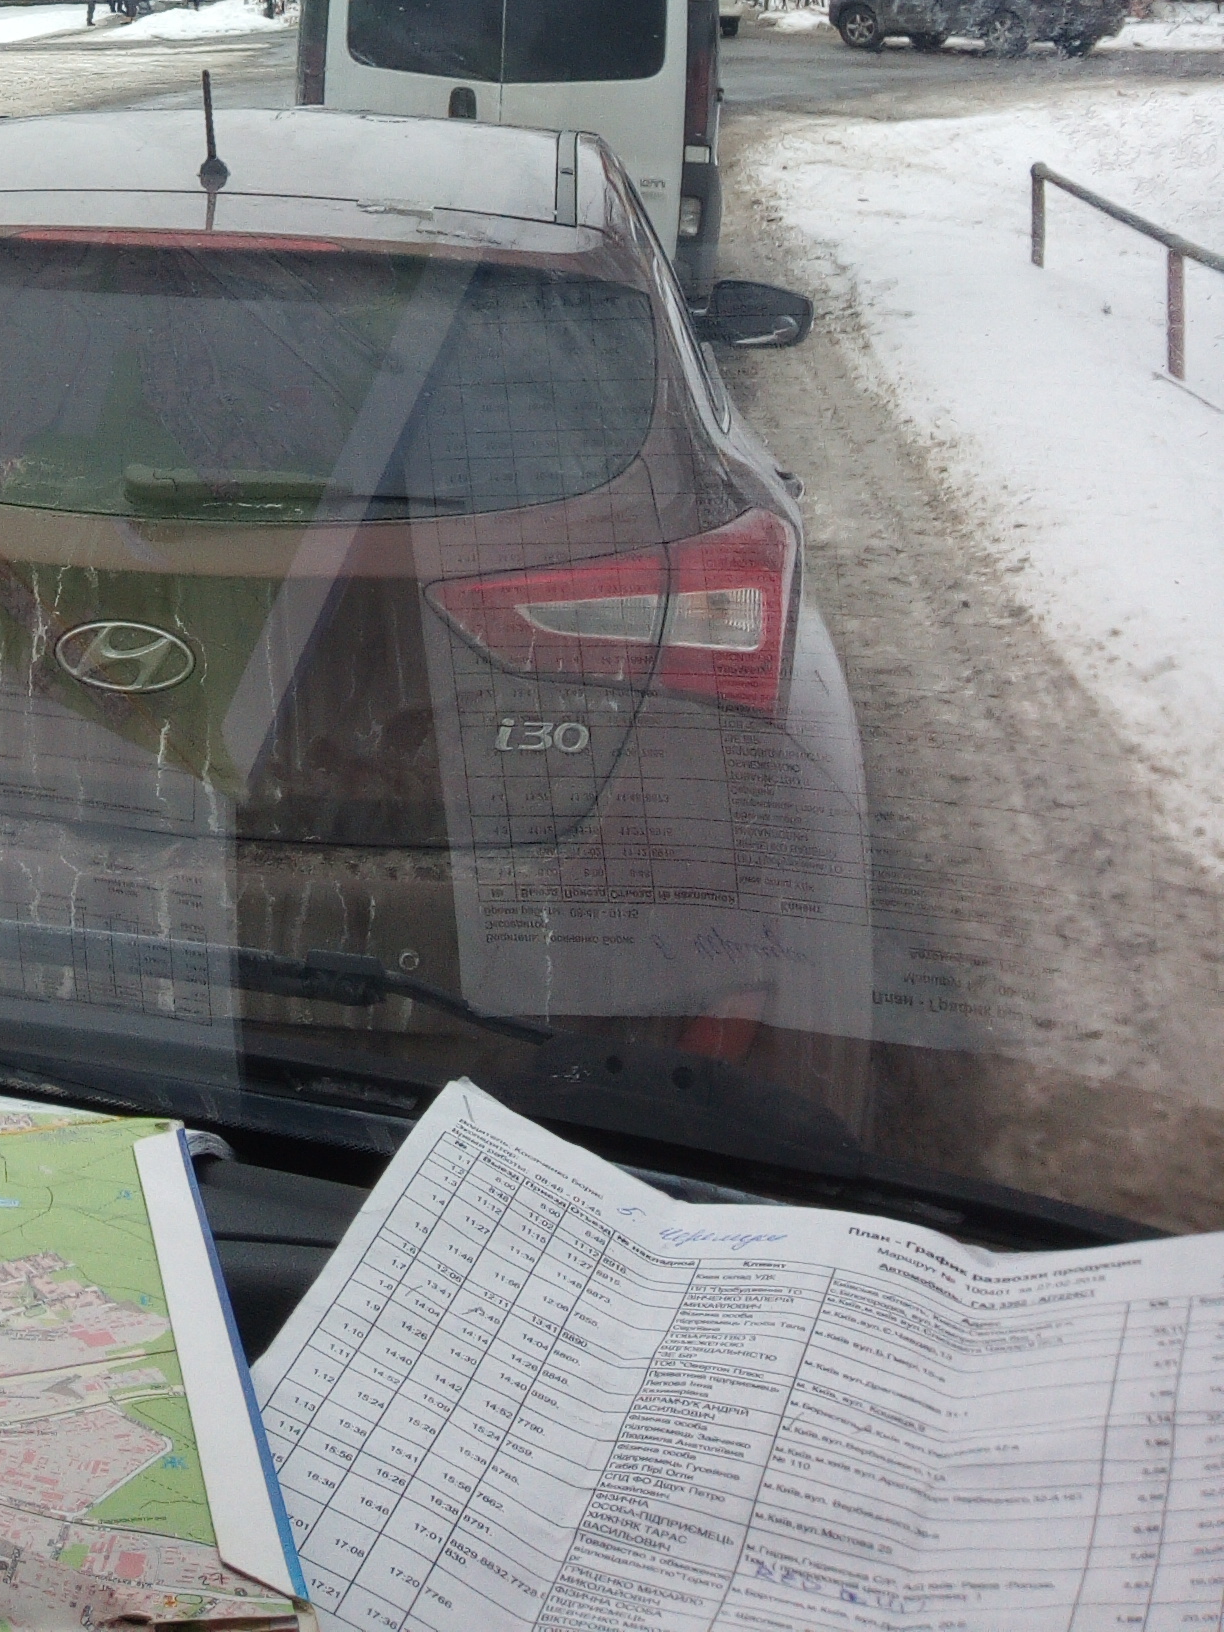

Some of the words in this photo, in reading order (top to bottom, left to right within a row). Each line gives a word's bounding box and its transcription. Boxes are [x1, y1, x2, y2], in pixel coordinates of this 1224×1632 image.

[495, 717, 590, 753] i30
[450, 1163, 466, 1176] 1.2
[457, 1154, 471, 1165] 1.1
[482, 1155, 521, 1182] Выезд
[443, 1175, 458, 1187] 1.3
[432, 1194, 446, 1206] 1.4
[525, 1180, 567, 1209] Приезд
[476, 1195, 503, 1216] 11:12
[573, 1195, 602, 1217] 01:45
[414, 1221, 429, 1234] 1.5
[464, 1216, 490, 1235] 11:27
[529, 1211, 554, 1230] 11:02
[570, 1206, 612, 1236] Отъезд
[521, 1224, 547, 1244] 11:15
[402, 1242, 417, 1255] 1.6
[448, 1244, 474, 1264] 11:48
[574, 1240, 600, 1258] 11:12
[848, 1226, 891, 1244] План
[905, 1240, 968, 1277] График
[391, 1258, 406, 1270] 1.7
[566, 1252, 593, 1271] 11:27
[877, 1247, 938, 1275] Маршрут
[379, 1278, 394, 1291] 1.8
[426, 1279, 452, 1299] 13:41
[556, 1271, 583, 1290] 11:48
[365, 1299, 381, 1312] 1.9
[414, 1299, 440, 1318] 14:04
[483, 1290, 510, 1308] 12:11
[343, 1322, 364, 1339] 1.10
[401, 1320, 428, 1340] 14:26
[531, 1315, 558, 1333] 13:41
[462, 1326, 489, 1346] 14:14
[522, 1333, 549, 1351] 14:04
[330, 1343, 351, 1358] 1.11
[385, 1346, 413, 1366] 14:40
[450, 1347, 477, 1366] 14:30
[314, 1368, 335, 1384] 1.12
[372, 1367, 401, 1386] 14:52
[435, 1374, 463, 1394] 14:42
[500, 1371, 528, 1391] 14:40
[294, 1396, 316, 1412] 1.13
[357, 1391, 385, 1410] 15:24
[422, 1393, 451, 1413] 15:09
[485, 1399, 514, 1419] 14:52
[278, 1419, 301, 1437] 1.14
[338, 1418, 368, 1438] 15:38
[472, 1422, 501, 1442] 15:24
[324, 1442, 354, 1462] 15:56
[389, 1444, 419, 1464] 15:41
[458, 1445, 488, 1466] 15:38
[306, 1470, 336, 1490] 16:38
[376, 1467, 407, 1487] 16:26
[441, 1472, 472, 1493] 15:56
[359, 1495, 390, 1516] 16:46
[429, 1494, 459, 1516] 16:38
[413, 1522, 443, 1544] 17:01
[582, 1519, 672, 1552] ВАСИЛЬОВИЧ
[587, 1510, 641, 1531] ХИЖНЯК
[644, 1523, 688, 1545] ТАРАС
[334, 1537, 365, 1558] 17:08
[389, 1566, 421, 1589] 17:20
[310, 1577, 341, 1599] 17:21
[366, 1607, 398, 1630] 17:36
